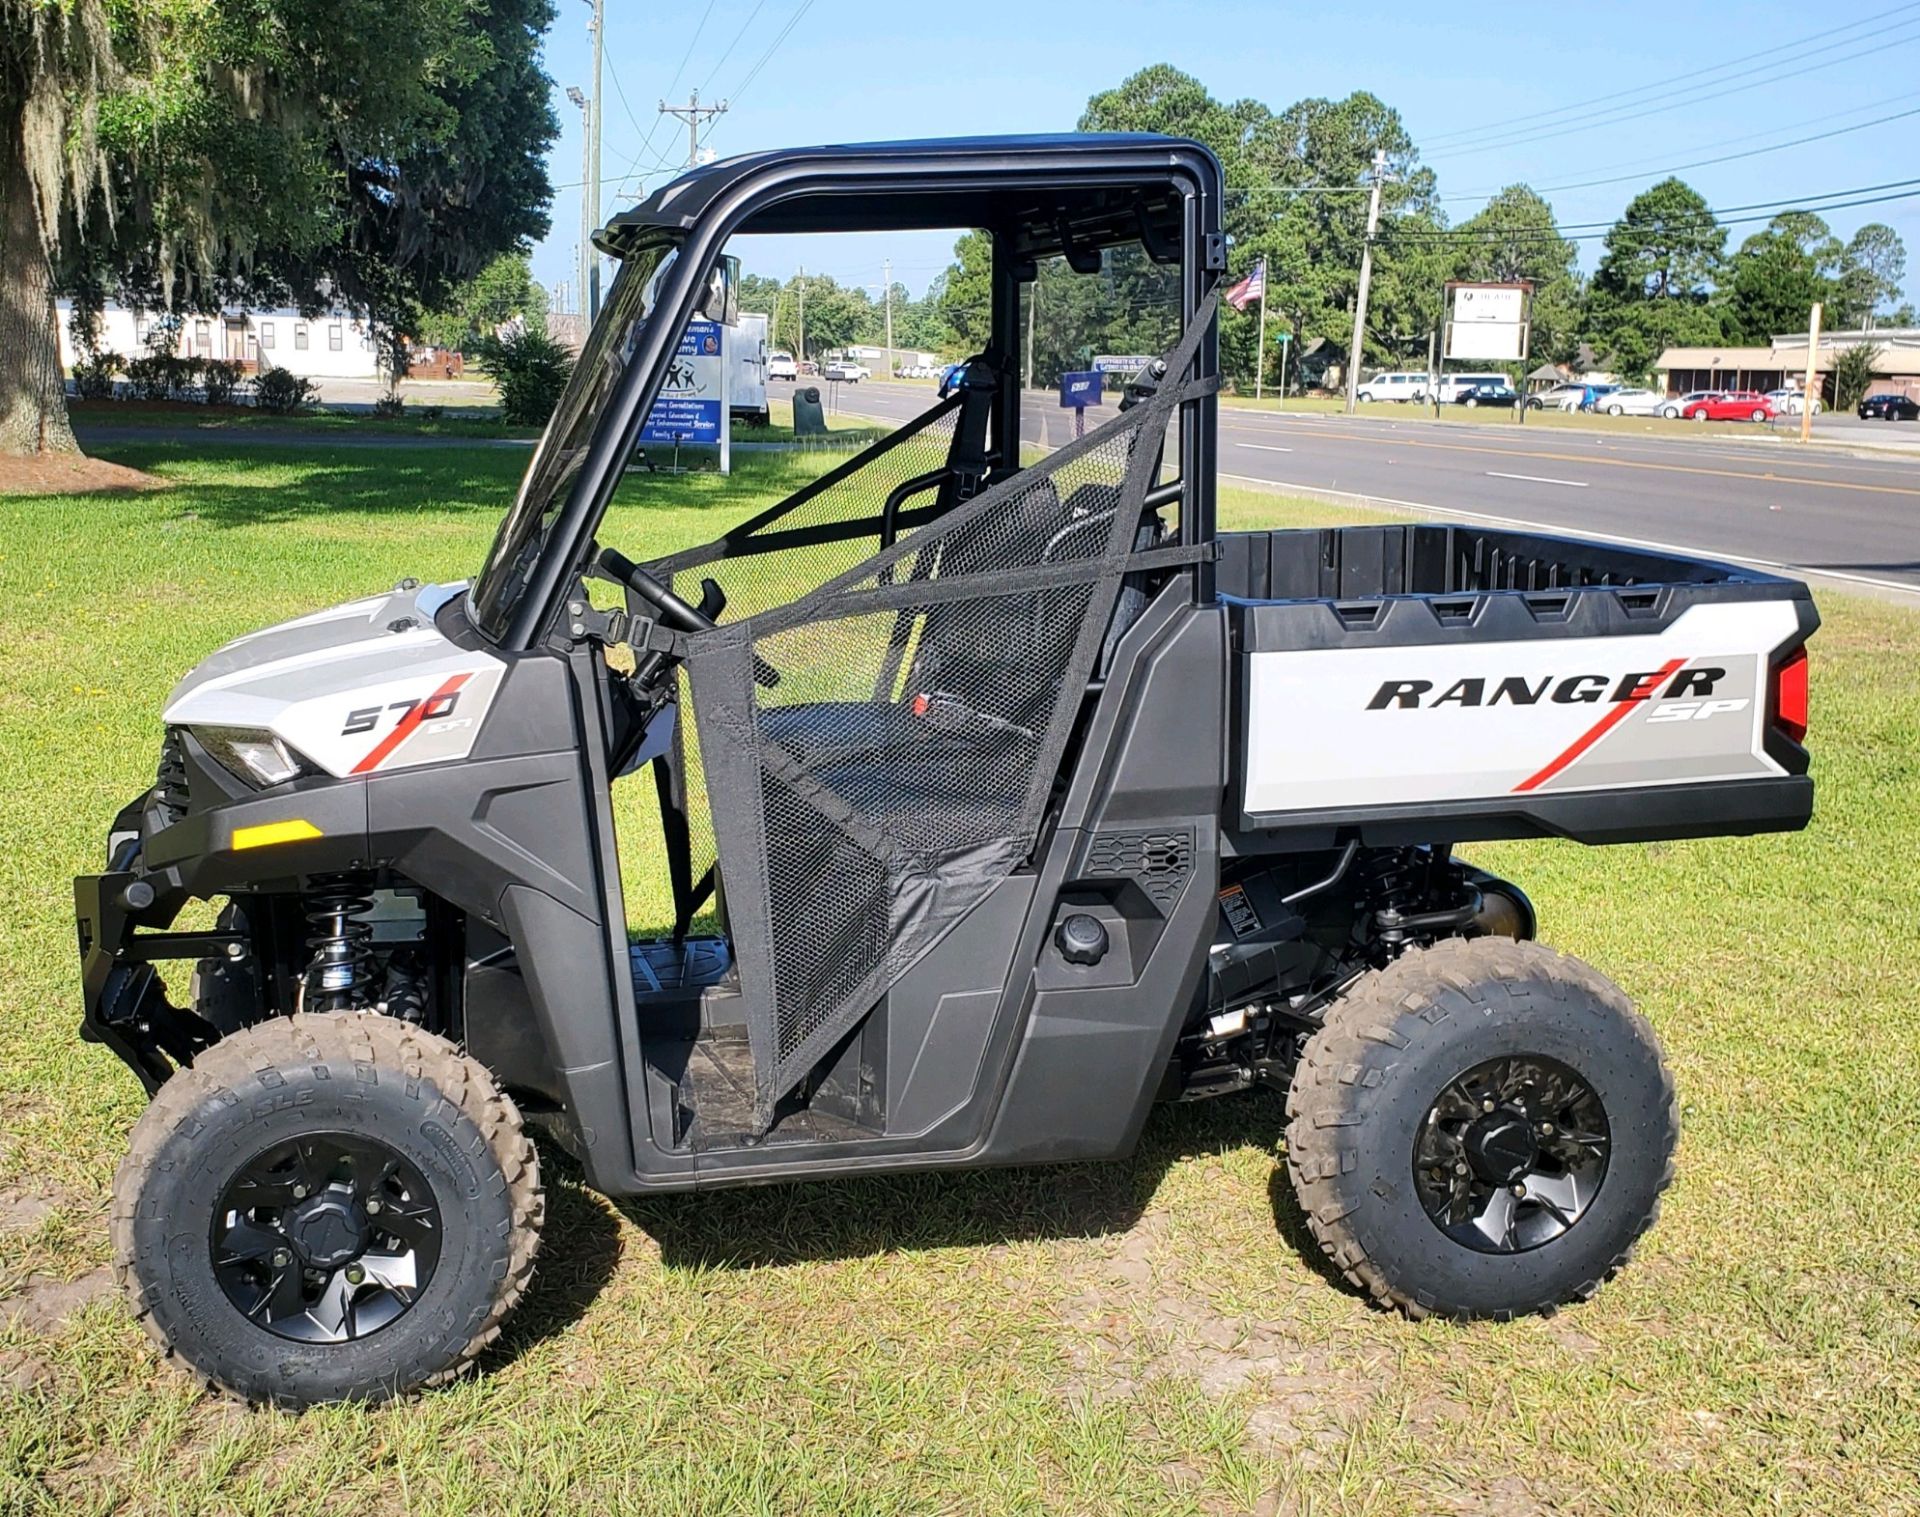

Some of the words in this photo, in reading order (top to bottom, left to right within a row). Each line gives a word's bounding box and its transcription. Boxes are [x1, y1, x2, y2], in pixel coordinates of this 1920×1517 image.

[657, 419, 692, 427] Enhancement
[669, 411, 694, 419] Education
[652, 430, 670, 439] Family
[1364, 666, 1727, 710] RANGER
[341, 691, 461, 736] 570
[1645, 697, 1750, 723] SP
